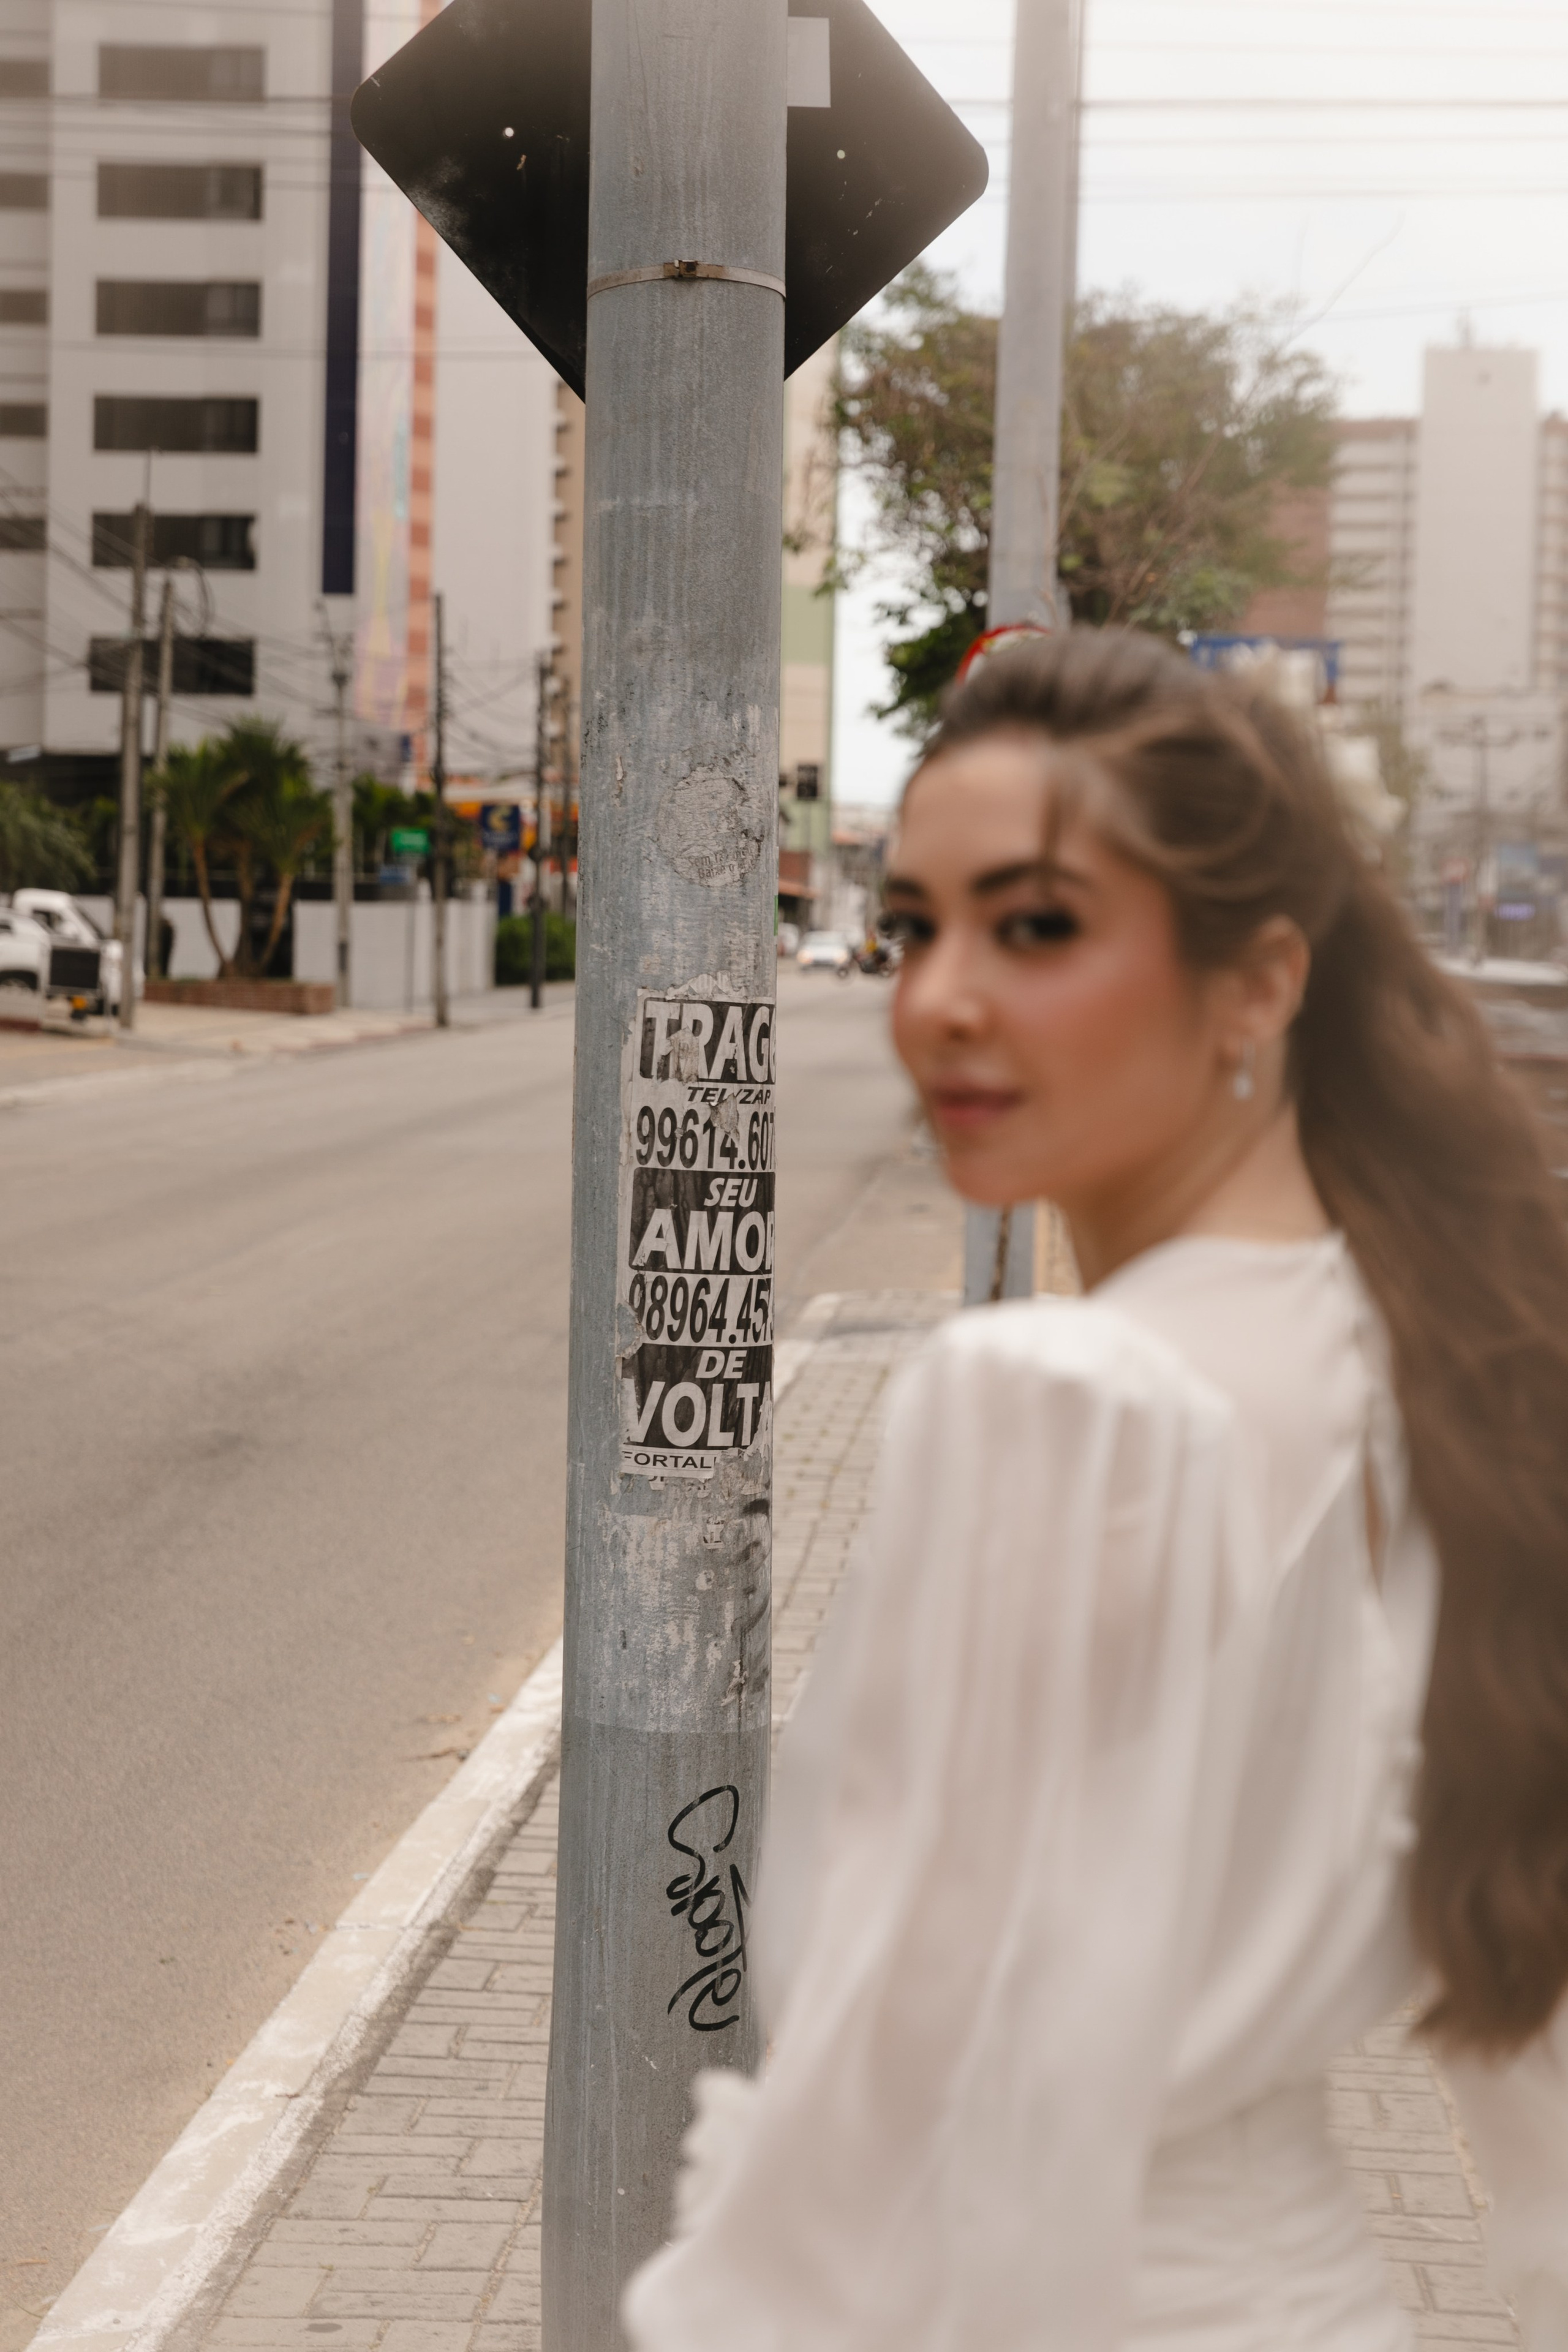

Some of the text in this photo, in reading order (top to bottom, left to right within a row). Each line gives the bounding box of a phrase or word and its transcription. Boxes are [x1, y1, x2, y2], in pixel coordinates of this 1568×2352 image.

[646, 1001, 775, 1083] TRAG
[704, 1177, 758, 1207] SEU
[695, 1350, 747, 1379] DE
[621, 1378, 771, 1447] VOLT
[622, 1451, 716, 1469] FORTAL
